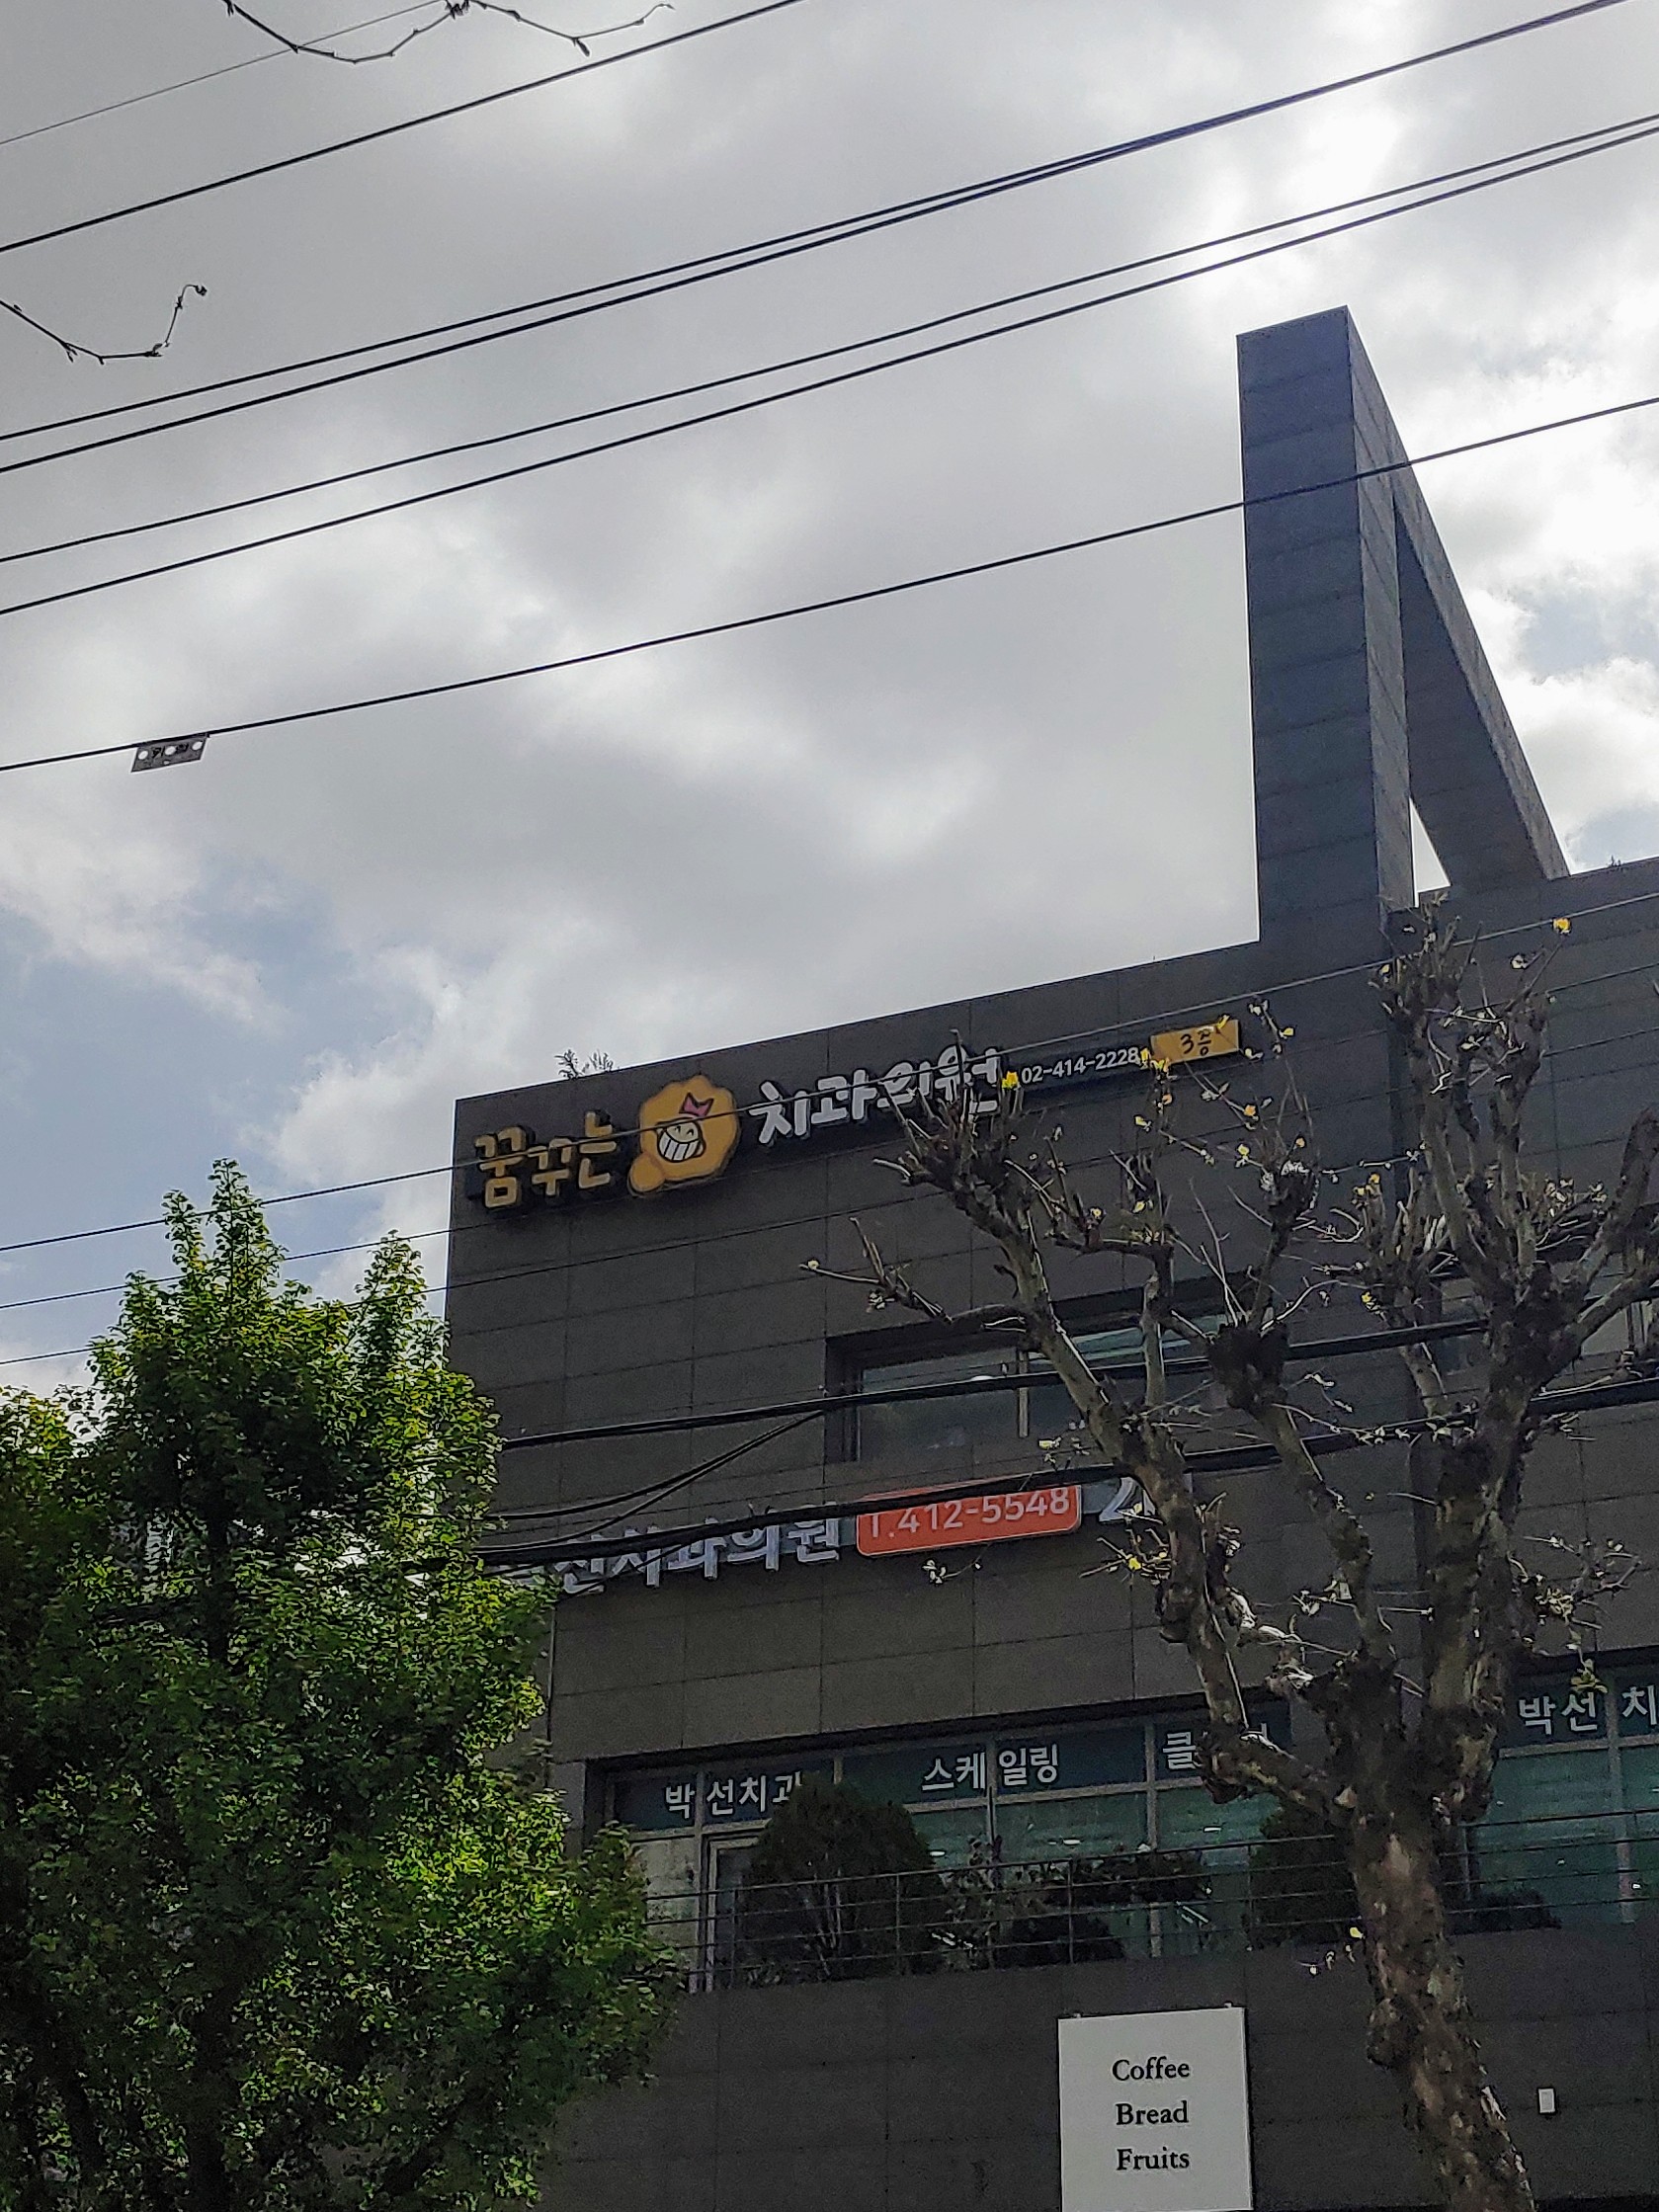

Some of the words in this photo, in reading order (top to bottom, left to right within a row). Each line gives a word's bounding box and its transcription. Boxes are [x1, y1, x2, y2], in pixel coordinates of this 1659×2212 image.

[1180, 1027, 1212, 1057] 3층
[1021, 1046, 1140, 1084] 02-414-2228
[475, 1111, 618, 1208] 꿈꾸는
[748, 1044, 999, 1144] 치과의원
[921, 1743, 1060, 1792] 스케일링
[1112, 2055, 1191, 2082] Coffee
[1116, 2100, 1190, 2125] Bread
[1116, 2146, 1191, 2171] Fruits
